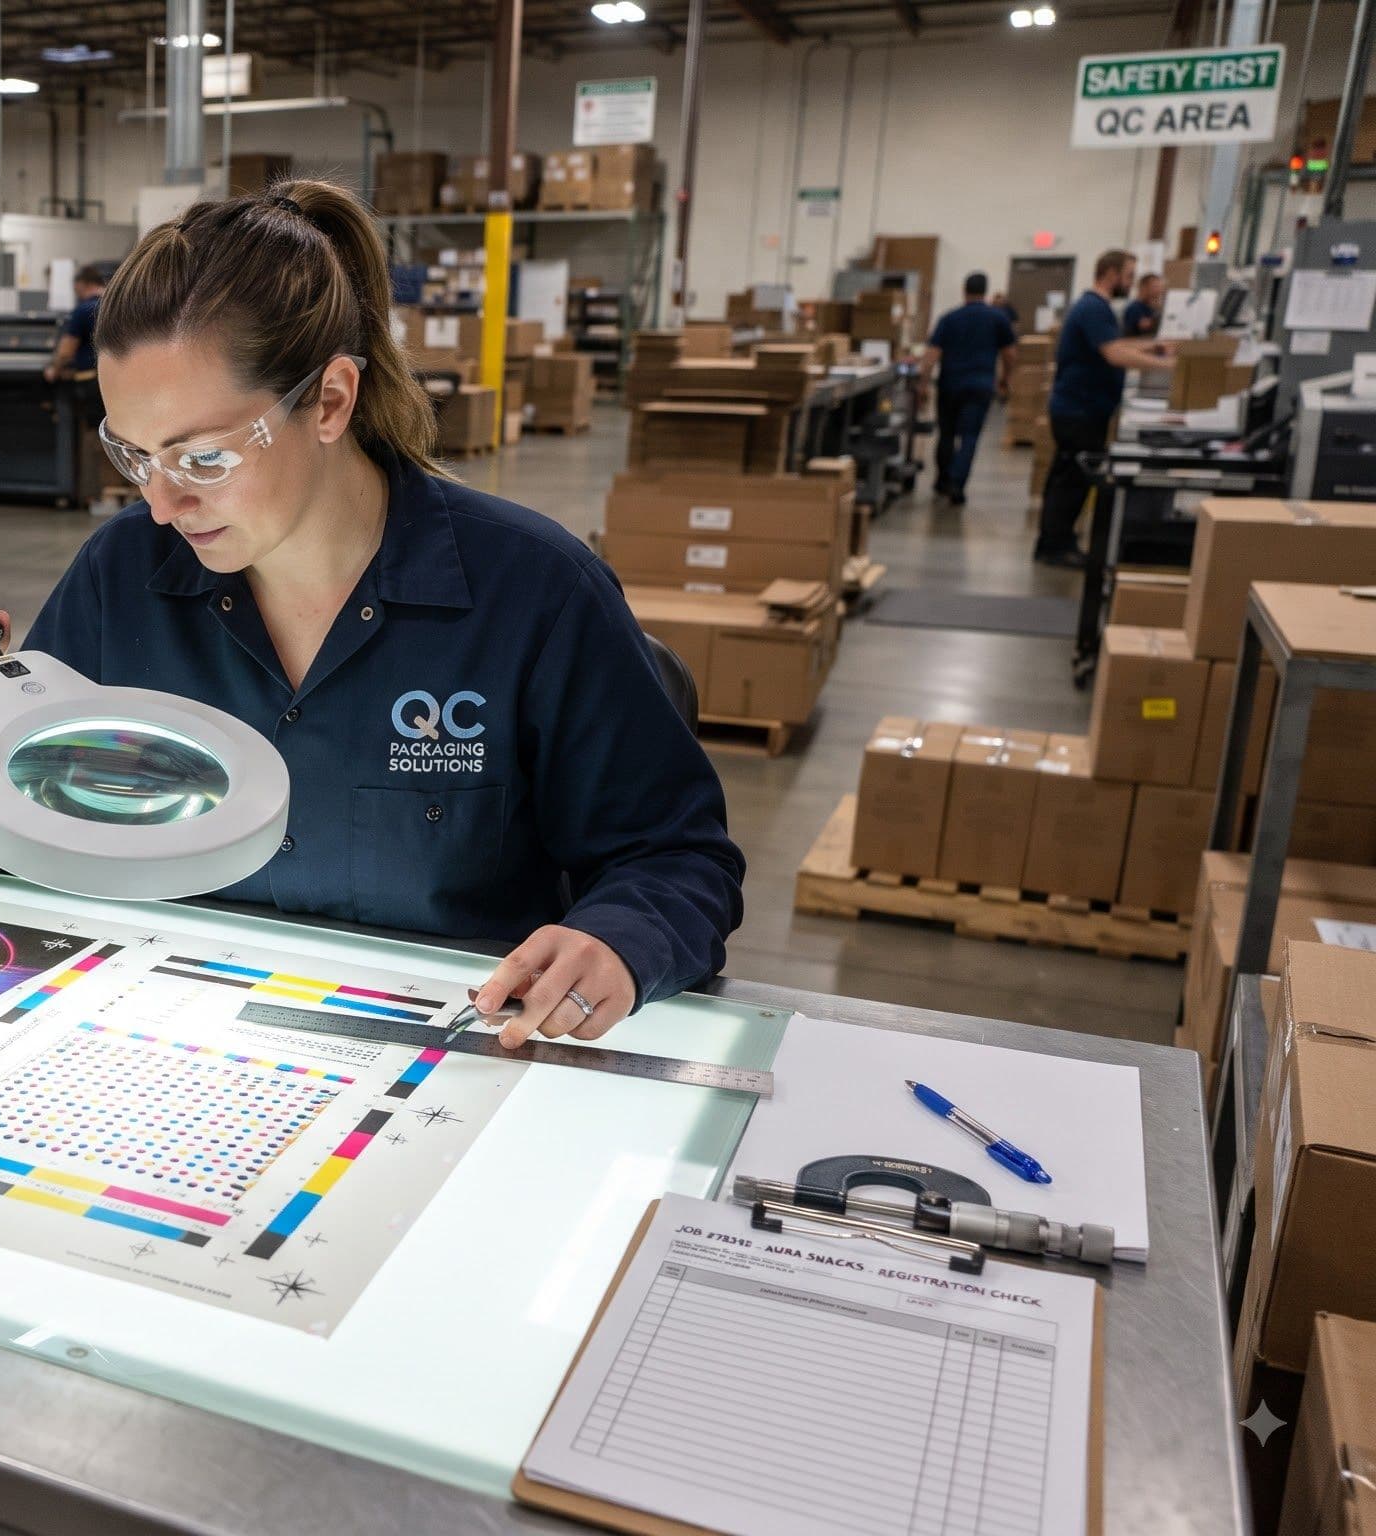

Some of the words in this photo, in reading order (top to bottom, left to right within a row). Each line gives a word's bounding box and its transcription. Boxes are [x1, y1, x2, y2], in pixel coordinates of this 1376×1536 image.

[1087, 61, 1191, 94] SAFETY
[1193, 56, 1276, 88] FIRST
[1096, 107, 1145, 135] QC
[1154, 102, 1251, 133] AREA
[391, 690, 486, 740] QC
[389, 758, 483, 773] SOLUTIONS
[390, 742, 485, 757] PACKAGING
[675, 1224, 703, 1236] JOB
[764, 1244, 802, 1259] AURA
[806, 1251, 865, 1272] SNACKS
[877, 1267, 986, 1296] REGISTRATION
[990, 1289, 1042, 1308] CHECK
